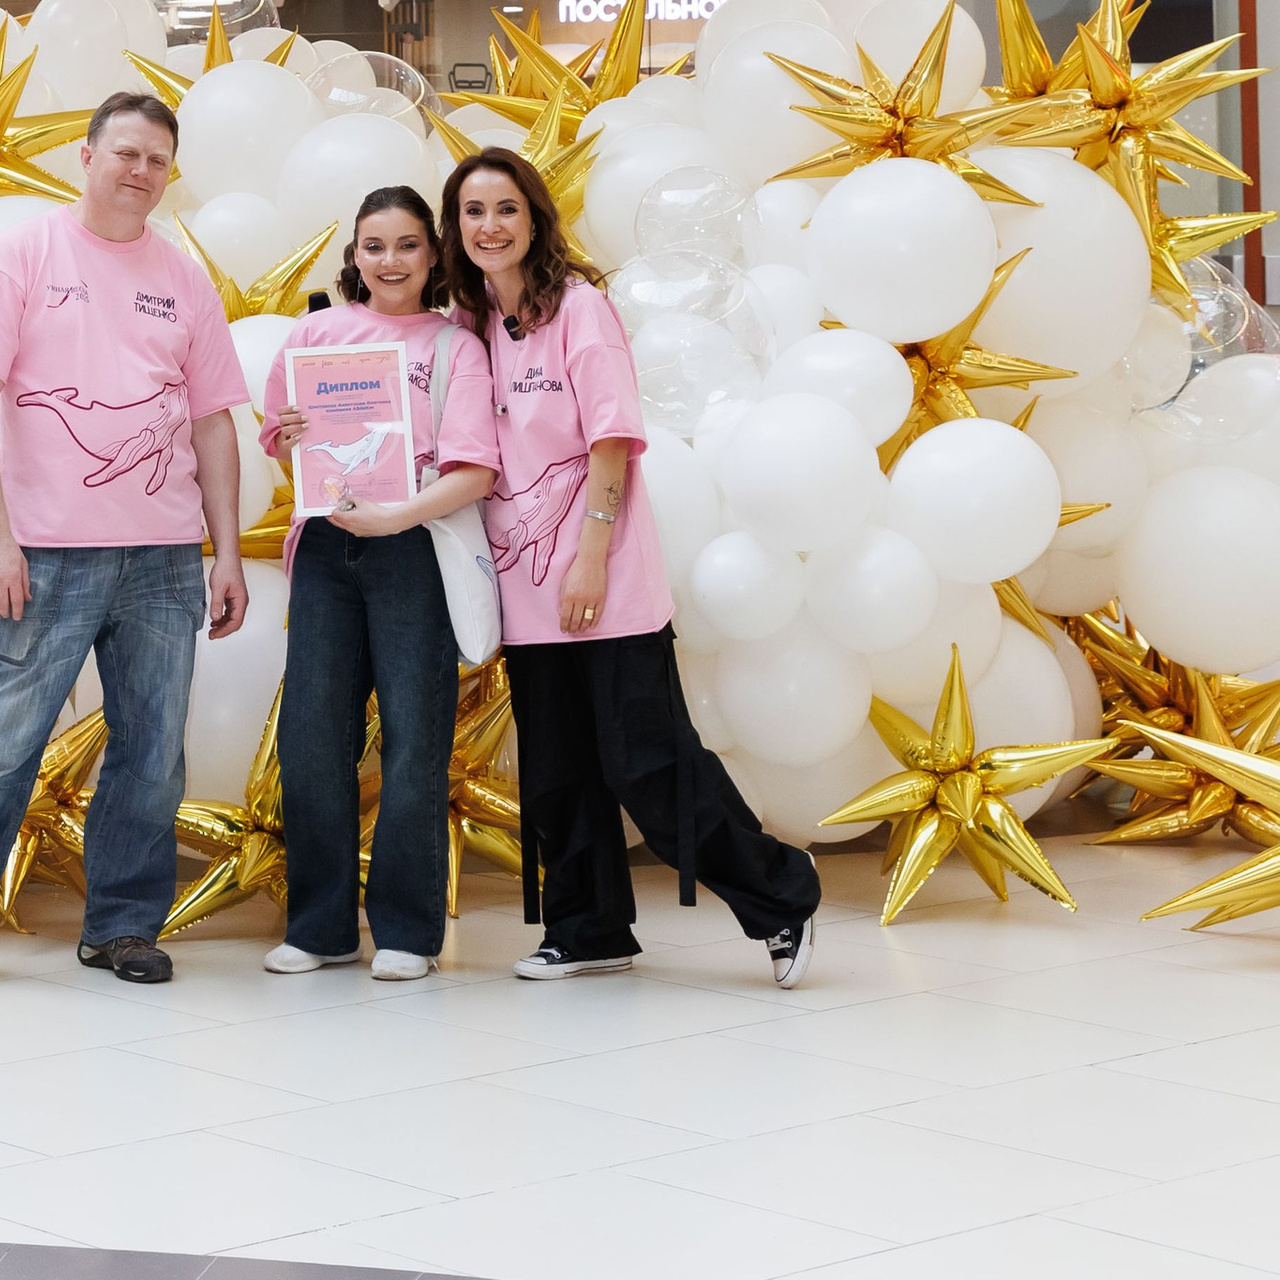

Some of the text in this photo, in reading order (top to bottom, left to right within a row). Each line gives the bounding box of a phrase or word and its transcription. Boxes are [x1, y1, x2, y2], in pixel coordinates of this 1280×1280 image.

[135, 291, 176, 310] ДМИТРИЙ
[133, 301, 178, 323] ТИЩЕНКО
[316, 380, 381, 395] Диплом
